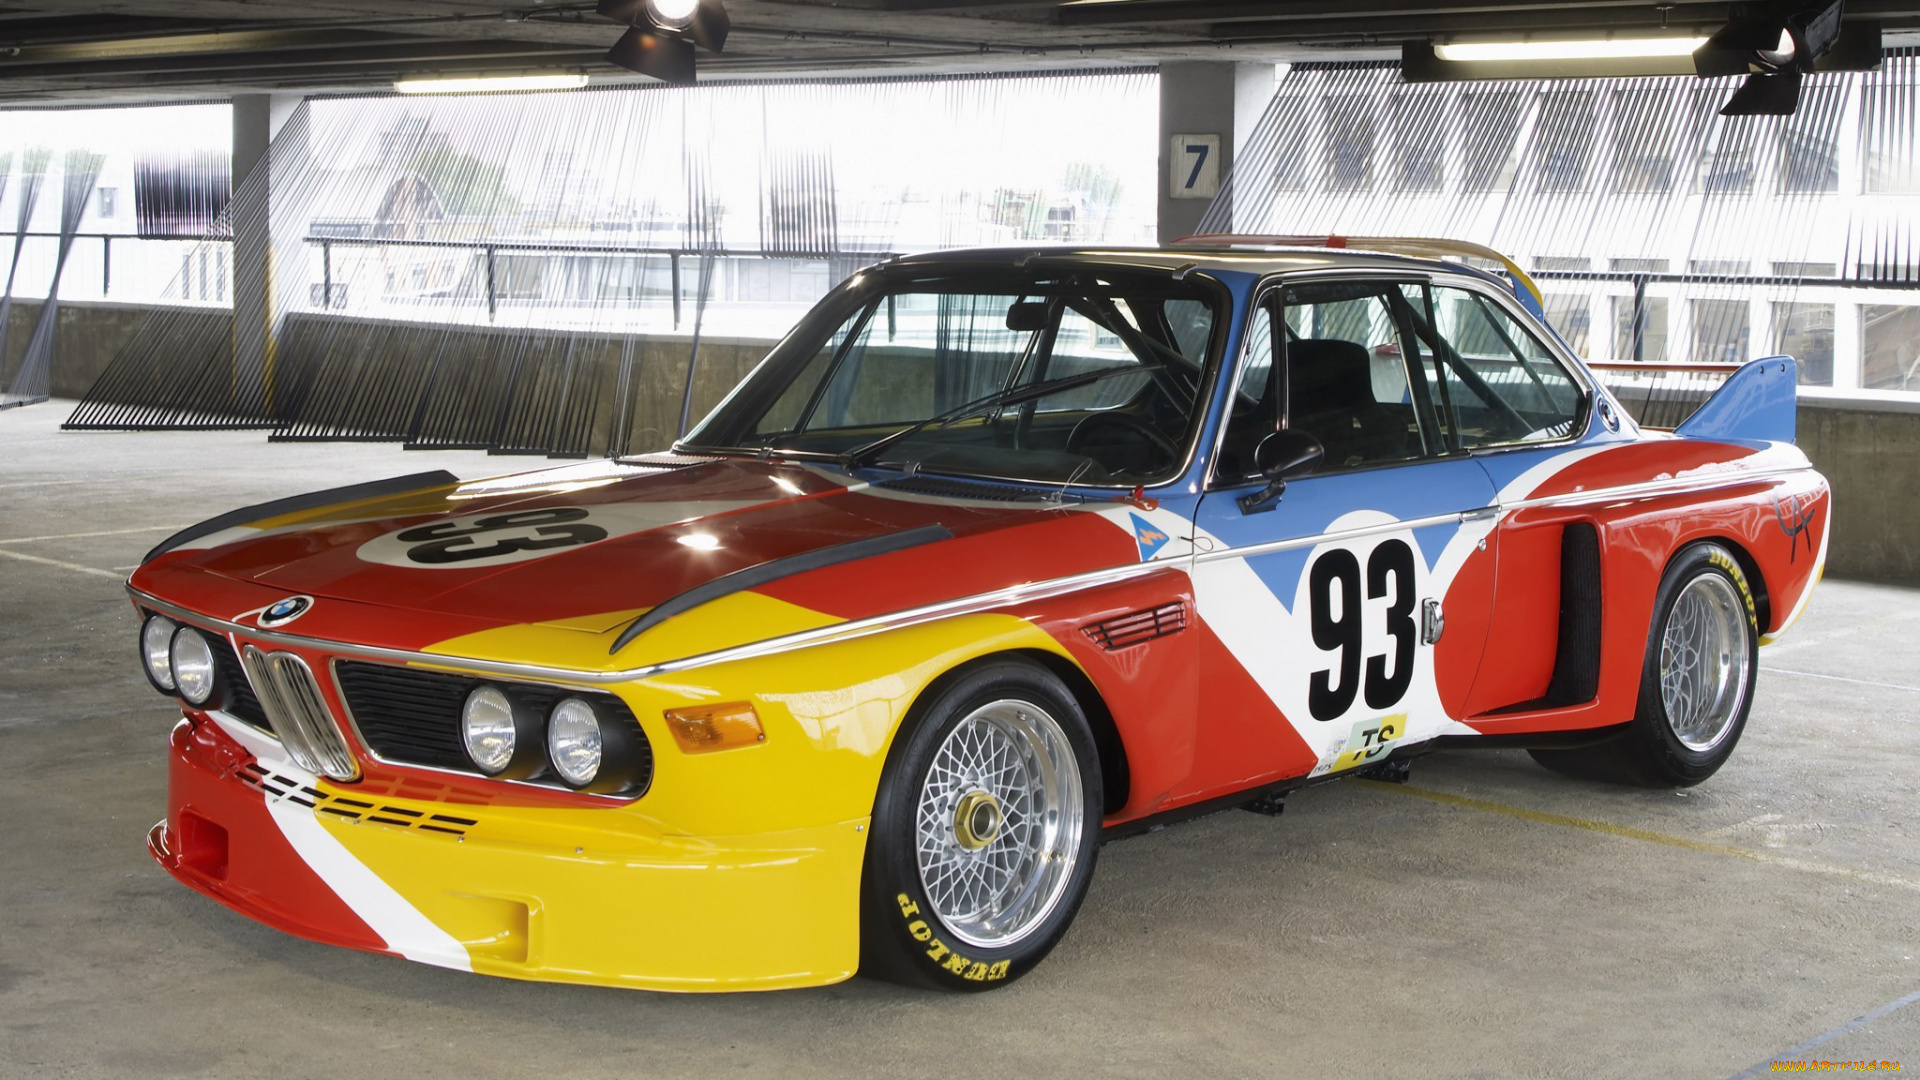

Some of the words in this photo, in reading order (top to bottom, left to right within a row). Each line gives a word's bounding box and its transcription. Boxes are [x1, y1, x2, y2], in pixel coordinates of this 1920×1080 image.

[1185, 145, 1209, 188] 7
[397, 507, 609, 564] 93
[1709, 549, 1758, 630] DUNLOP
[1308, 538, 1417, 722] 93
[1352, 725, 1394, 762] TS
[897, 893, 1011, 981] DUNLOP
